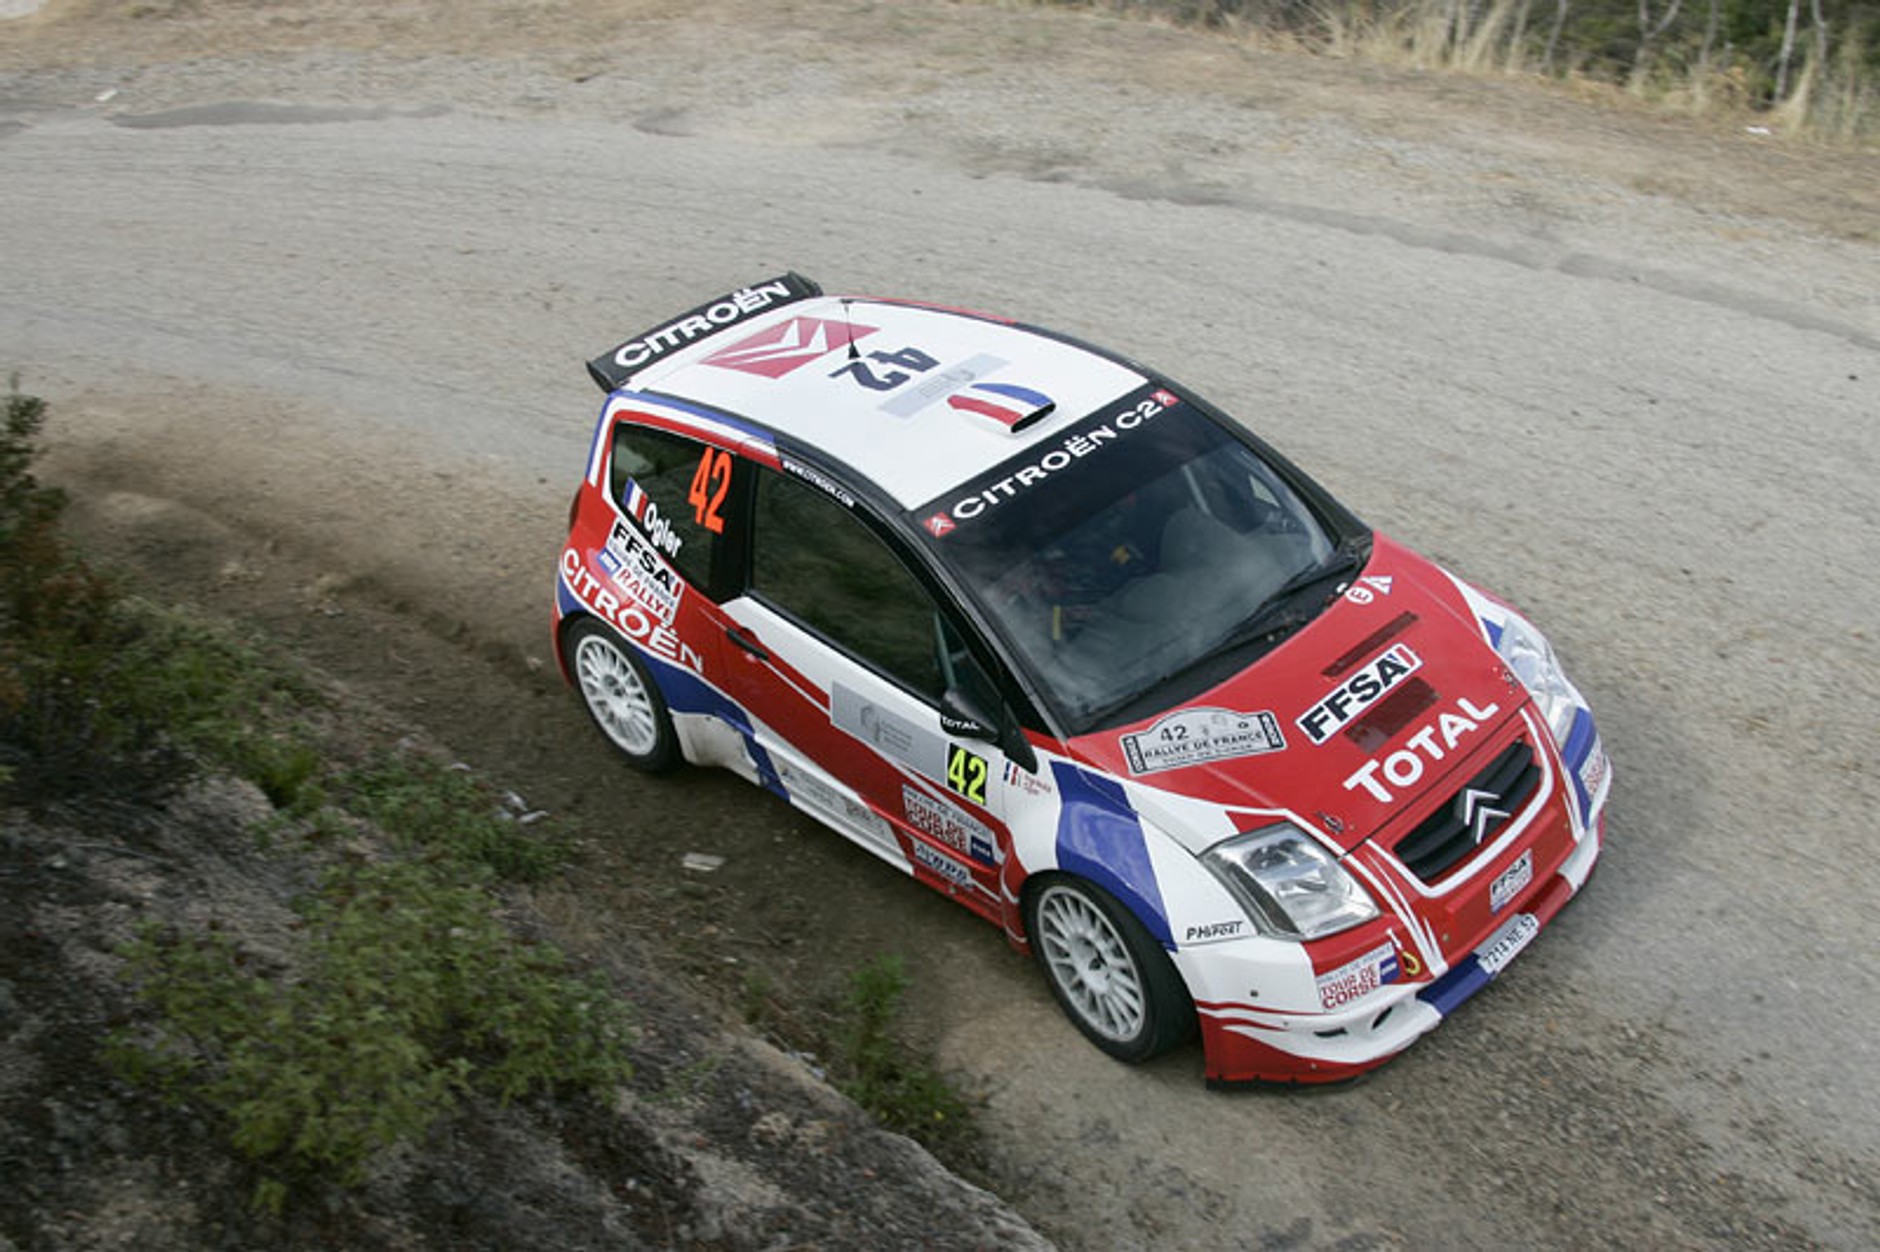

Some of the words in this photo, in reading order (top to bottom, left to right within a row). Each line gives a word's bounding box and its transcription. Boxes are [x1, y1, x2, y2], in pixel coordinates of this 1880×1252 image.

[614, 281, 792, 368] CITROËN
[828, 347, 941, 391] 42
[688, 446, 732, 535] 42
[952, 425, 1118, 520] CITROËN
[1115, 399, 1164, 429] C2
[613, 522, 671, 592] FFSA
[563, 548, 703, 674] CITROËN
[941, 715, 980, 731] TOTAL
[1299, 656, 1411, 742] FFSA
[1144, 742, 1188, 759] RALLYE
[1193, 740, 1210, 751] DE
[1212, 731, 1263, 748] FRANCE
[1160, 724, 1190, 742] 42
[1342, 697, 1500, 803] TOTAL
[948, 748, 987, 805] 42
[1320, 974, 1356, 996] TOUR
[1360, 962, 1378, 982] DE
[1322, 976, 1378, 1010] CORSE
